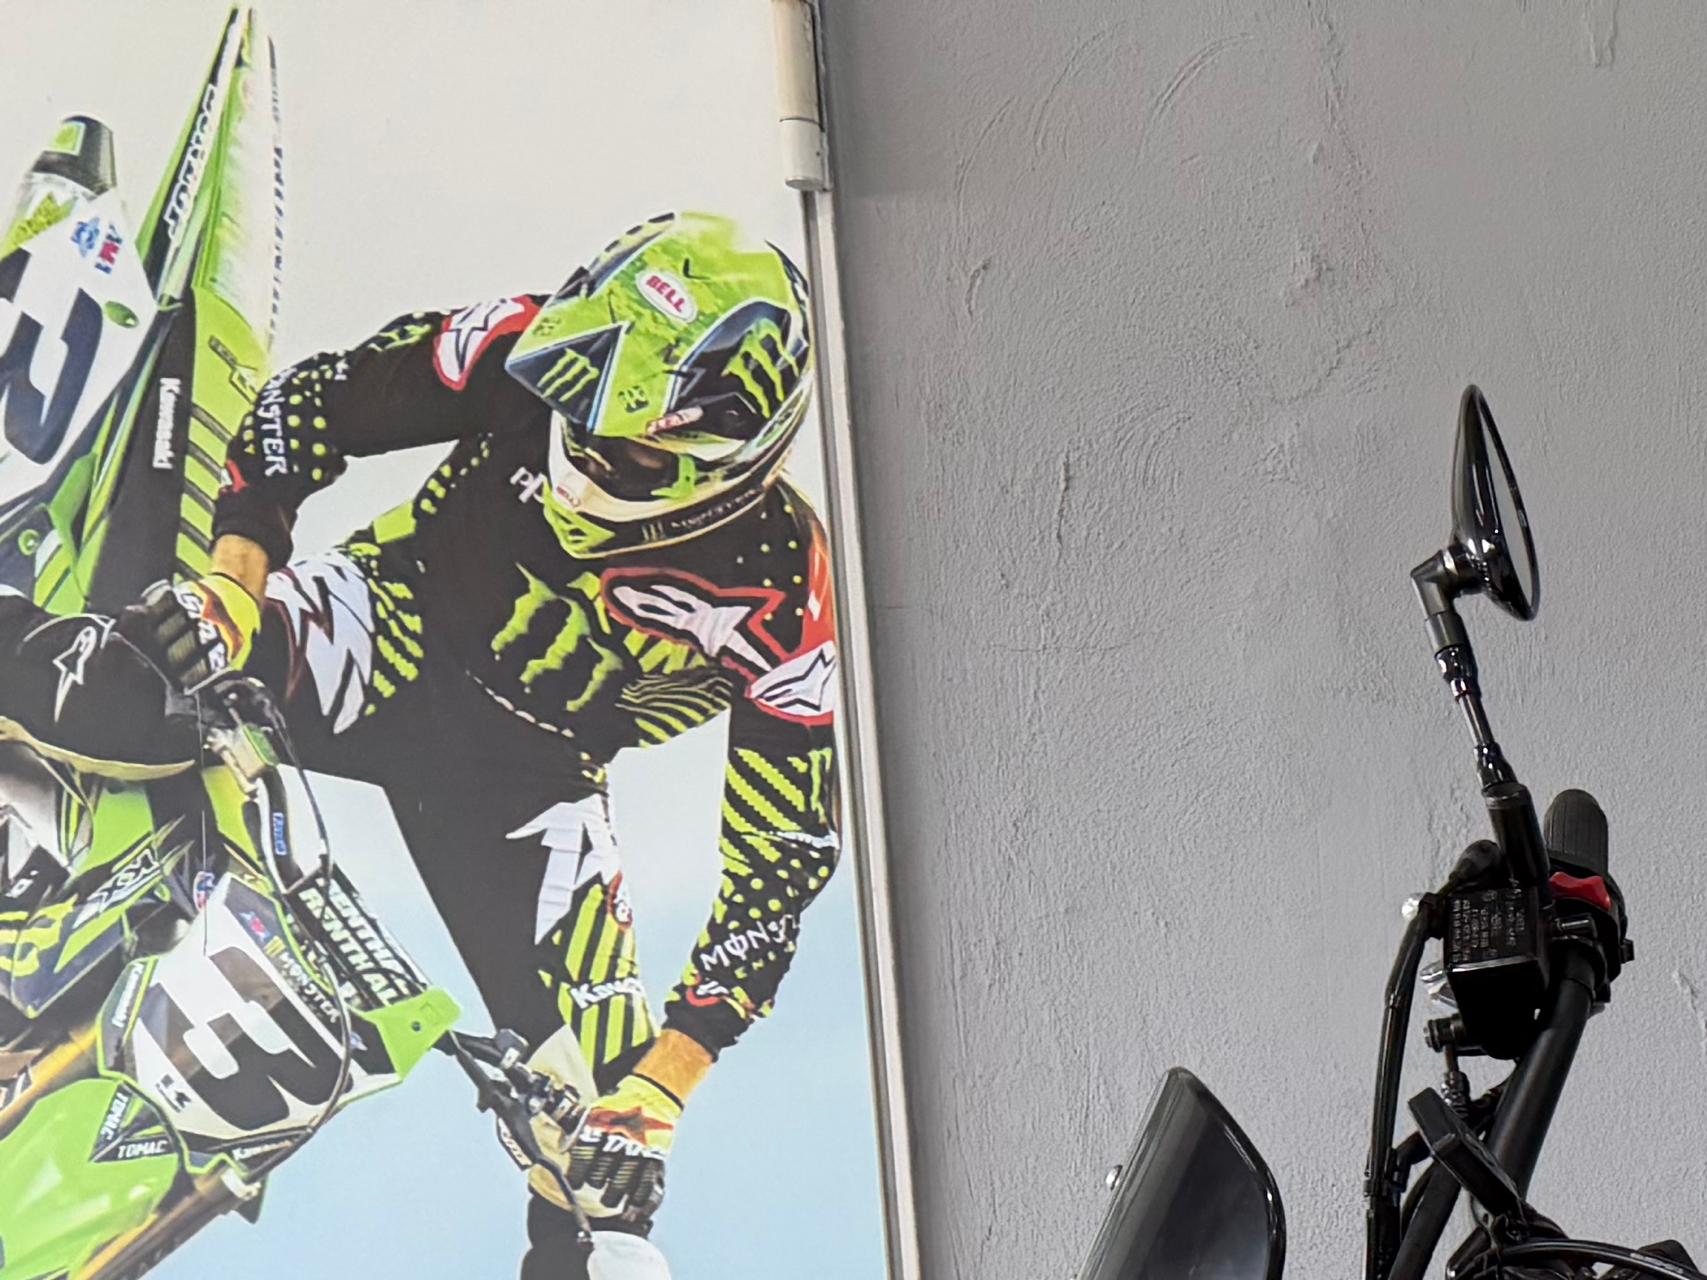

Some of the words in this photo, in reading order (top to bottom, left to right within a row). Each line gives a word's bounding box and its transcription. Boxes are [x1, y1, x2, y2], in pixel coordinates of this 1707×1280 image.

[645, 275, 688, 314] BELL
[298, 888, 400, 1006] RENTHAL
[117, 1139, 169, 1160] TOMAC
